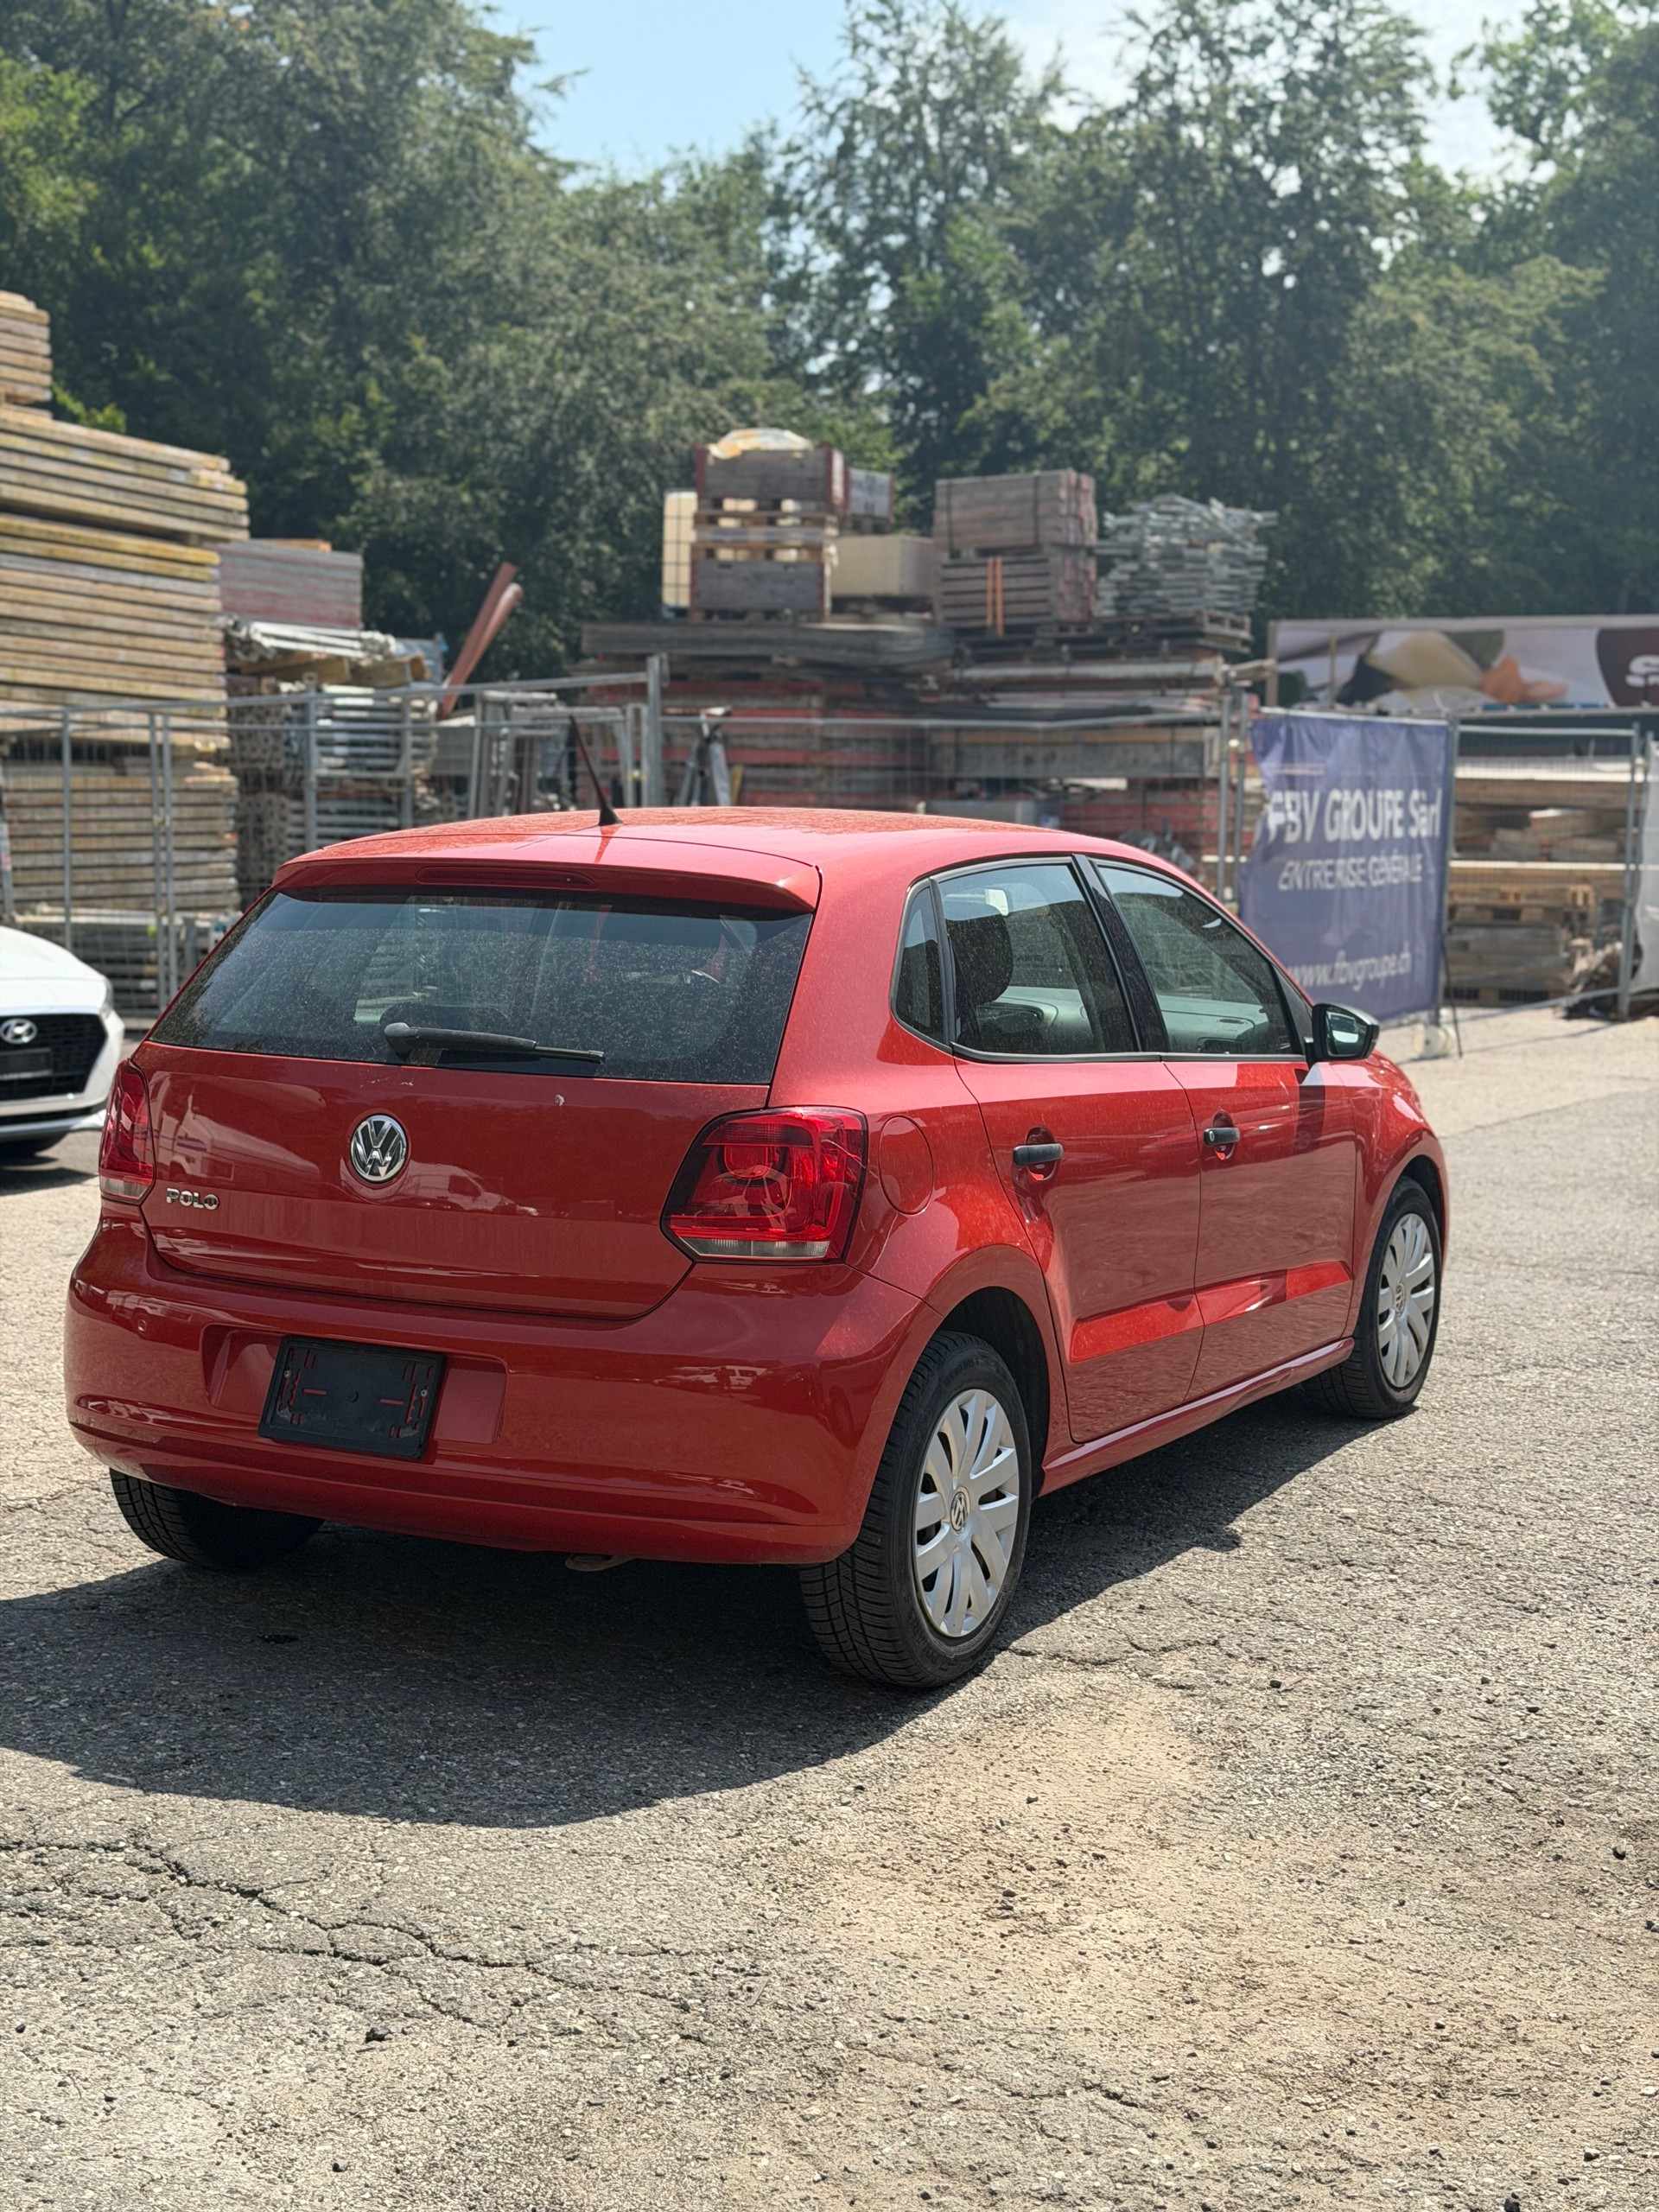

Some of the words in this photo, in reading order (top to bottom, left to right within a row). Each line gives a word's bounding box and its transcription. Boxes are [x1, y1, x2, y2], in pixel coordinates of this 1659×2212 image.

[1264, 788, 1320, 844] FBV
[1324, 787, 1404, 842] GROUPE
[165, 1186, 219, 1211] POLO
